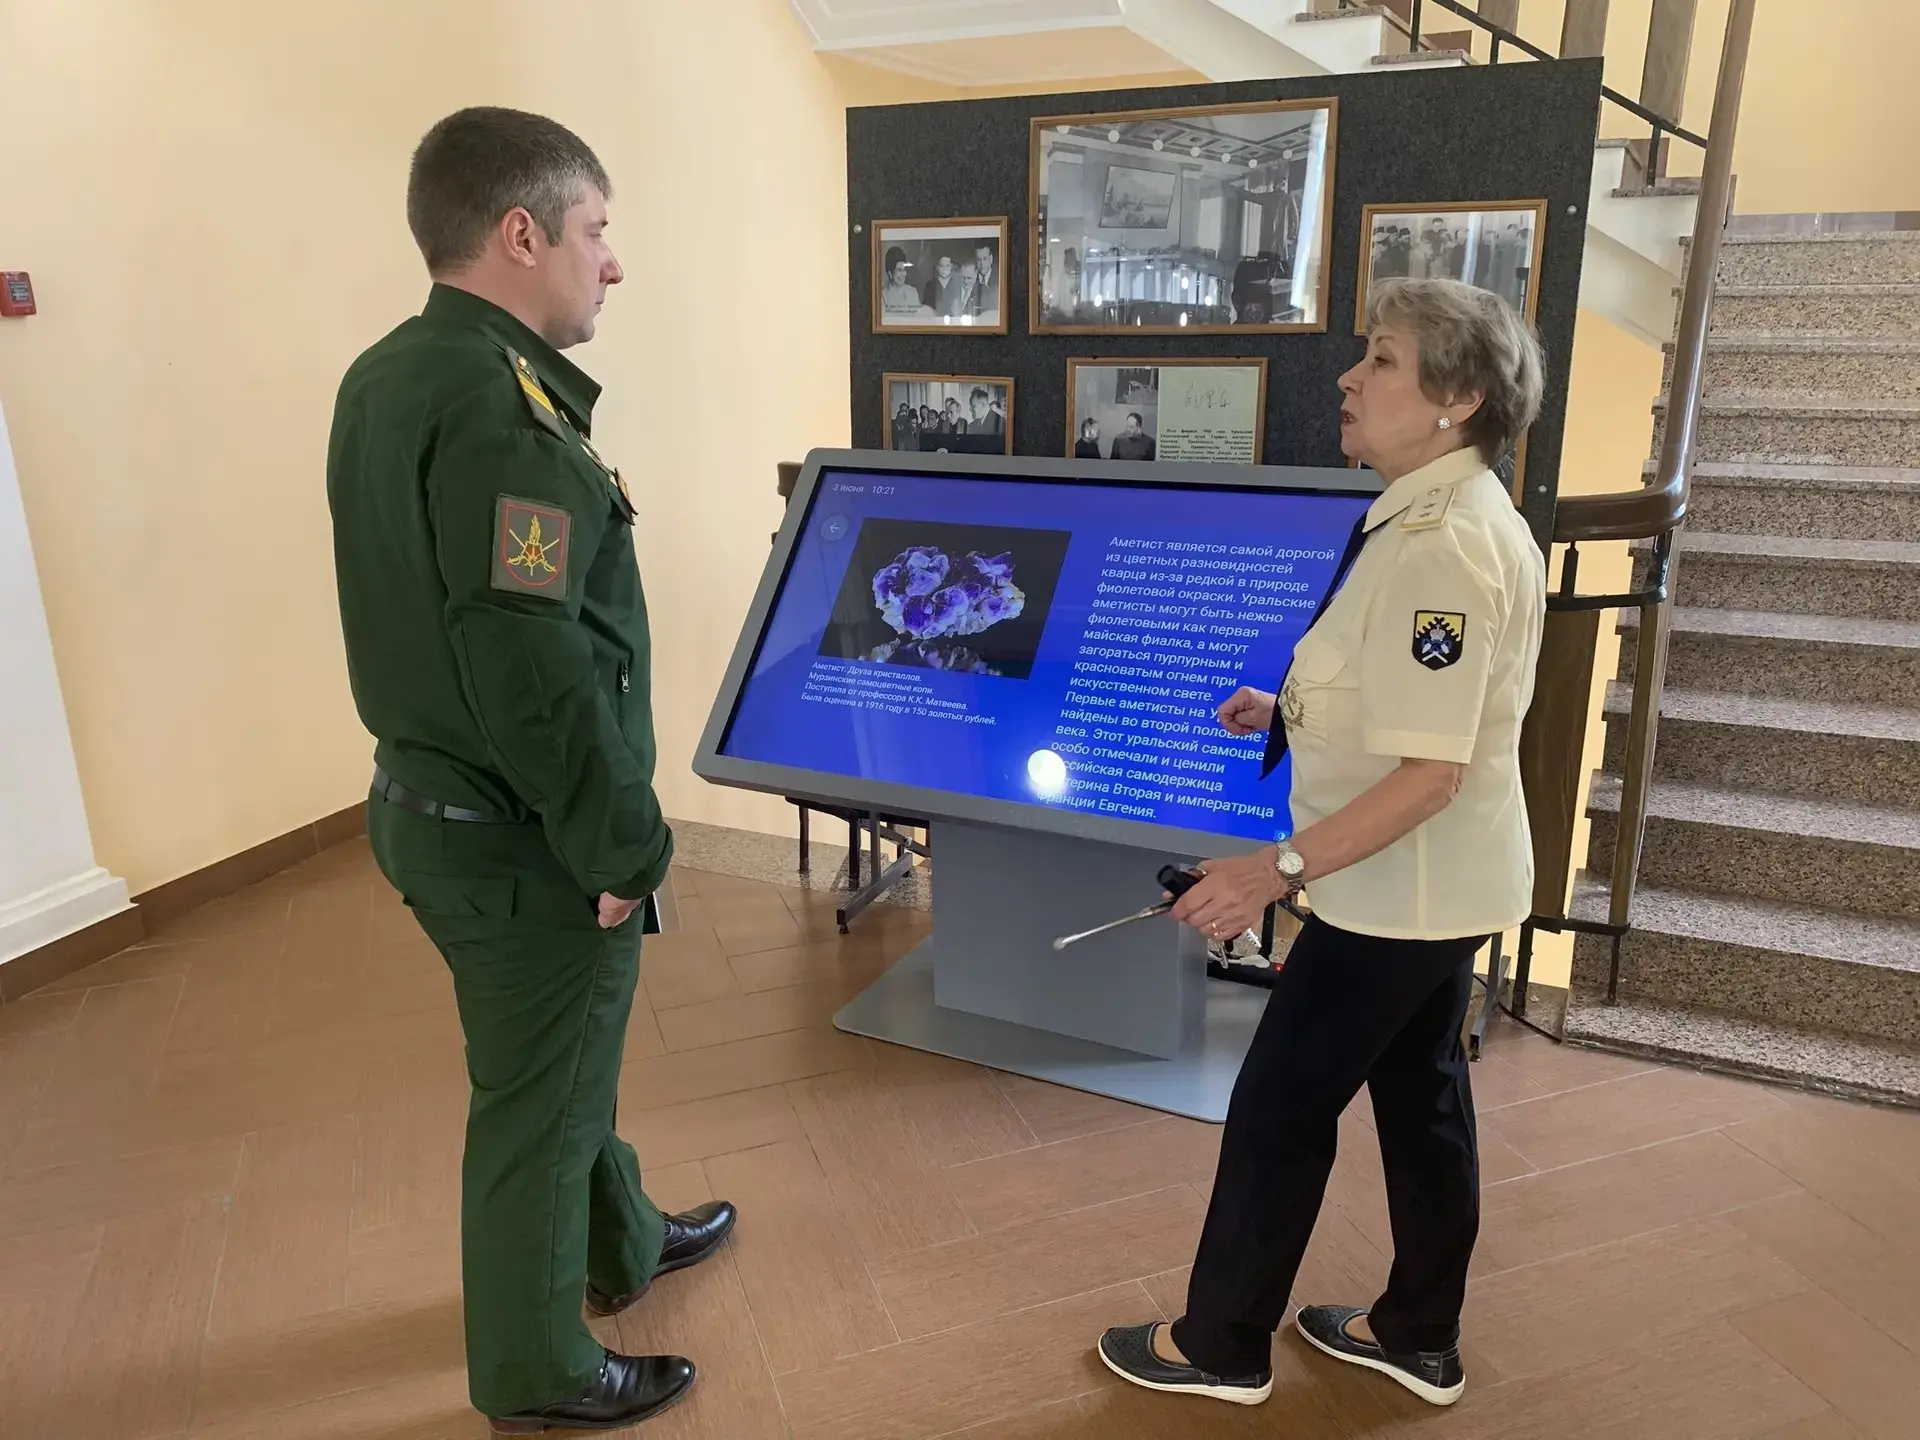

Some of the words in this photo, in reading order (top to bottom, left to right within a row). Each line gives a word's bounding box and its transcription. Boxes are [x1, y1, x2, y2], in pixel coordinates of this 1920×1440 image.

[872, 486, 894, 495] 10:21
[1110, 537, 1164, 550] Аметист
[1166, 542, 1226, 554] является
[1230, 545, 1272, 556] самой
[1276, 548, 1335, 560] дорогой
[1105, 553, 1120, 562] из
[1123, 555, 1178, 567] цветных
[1181, 558, 1293, 574] разновидностей
[1101, 569, 1146, 582] кварца
[1150, 573, 1183, 582] из-за
[1186, 573, 1234, 587] редкой
[1238, 579, 1245, 587] в
[1249, 579, 1309, 593] природе
[1096, 582, 1174, 598] фиолетовой
[1178, 590, 1236, 603] окраски.
[1241, 593, 1315, 609] Уральские
[1092, 599, 1155, 612] аметисты
[1158, 605, 1197, 617] могут
[1200, 606, 1234, 619] быть
[1237, 612, 1283, 623] нежно
[1088, 614, 1179, 631] фиолетовыми
[1183, 623, 1206, 633] как
[1210, 625, 1259, 639] первая
[1083, 630, 1138, 644] майская
[1141, 636, 1193, 650] фиалка,
[1197, 641, 1205, 650] а
[1208, 642, 1250, 655] могут
[1079, 646, 1150, 662] загораться
[1153, 652, 1231, 670] пурпурным
[1234, 661, 1244, 671] и
[808, 672, 856, 685] Мурзинские
[857, 679, 911, 693] самоцветные
[913, 686, 934, 694] копи.
[847, 666, 871, 677] Друза
[873, 670, 922, 682] кристаллов.
[1074, 662, 1163, 680] красноватым
[1167, 671, 1207, 684] огнем
[1210, 676, 1237, 688] при
[805, 682, 847, 694] Поступила
[858, 690, 906, 703] профессора
[925, 697, 968, 710] Матвеева.
[1069, 676, 1170, 697] искусственном
[1173, 688, 1214, 702] свете.
[801, 692, 822, 702] Была
[824, 696, 856, 707] оценена
[865, 701, 884, 710] 1916
[885, 705, 903, 714] году
[912, 707, 927, 716] 150
[928, 711, 963, 721] золотых
[964, 715, 997, 725] рублей.
[1065, 691, 1116, 708] Первые
[1119, 698, 1186, 716] аметисты
[1189, 707, 1206, 718] на
[1060, 709, 1118, 724] найдены
[1122, 715, 1137, 727] во
[1141, 717, 1189, 735] второй
[1056, 725, 1088, 738] века.
[1093, 729, 1124, 742] Этот
[1125, 734, 1199, 752] уральский
[1202, 742, 1264, 762] самоцве
[1051, 740, 1090, 753] особо
[1093, 746, 1158, 764] отмечали
[1161, 755, 1170, 765] и
[1173, 755, 1225, 774] ценили
[1064, 760, 1123, 777] ссийская
[1126, 768, 1223, 792] самодержица
[1065, 777, 1109, 793] терина
[1113, 783, 1161, 802] Вторая
[1164, 792, 1174, 802] и
[1177, 794, 1274, 818] императрица
[1098, 799, 1156, 819] Евгения.
